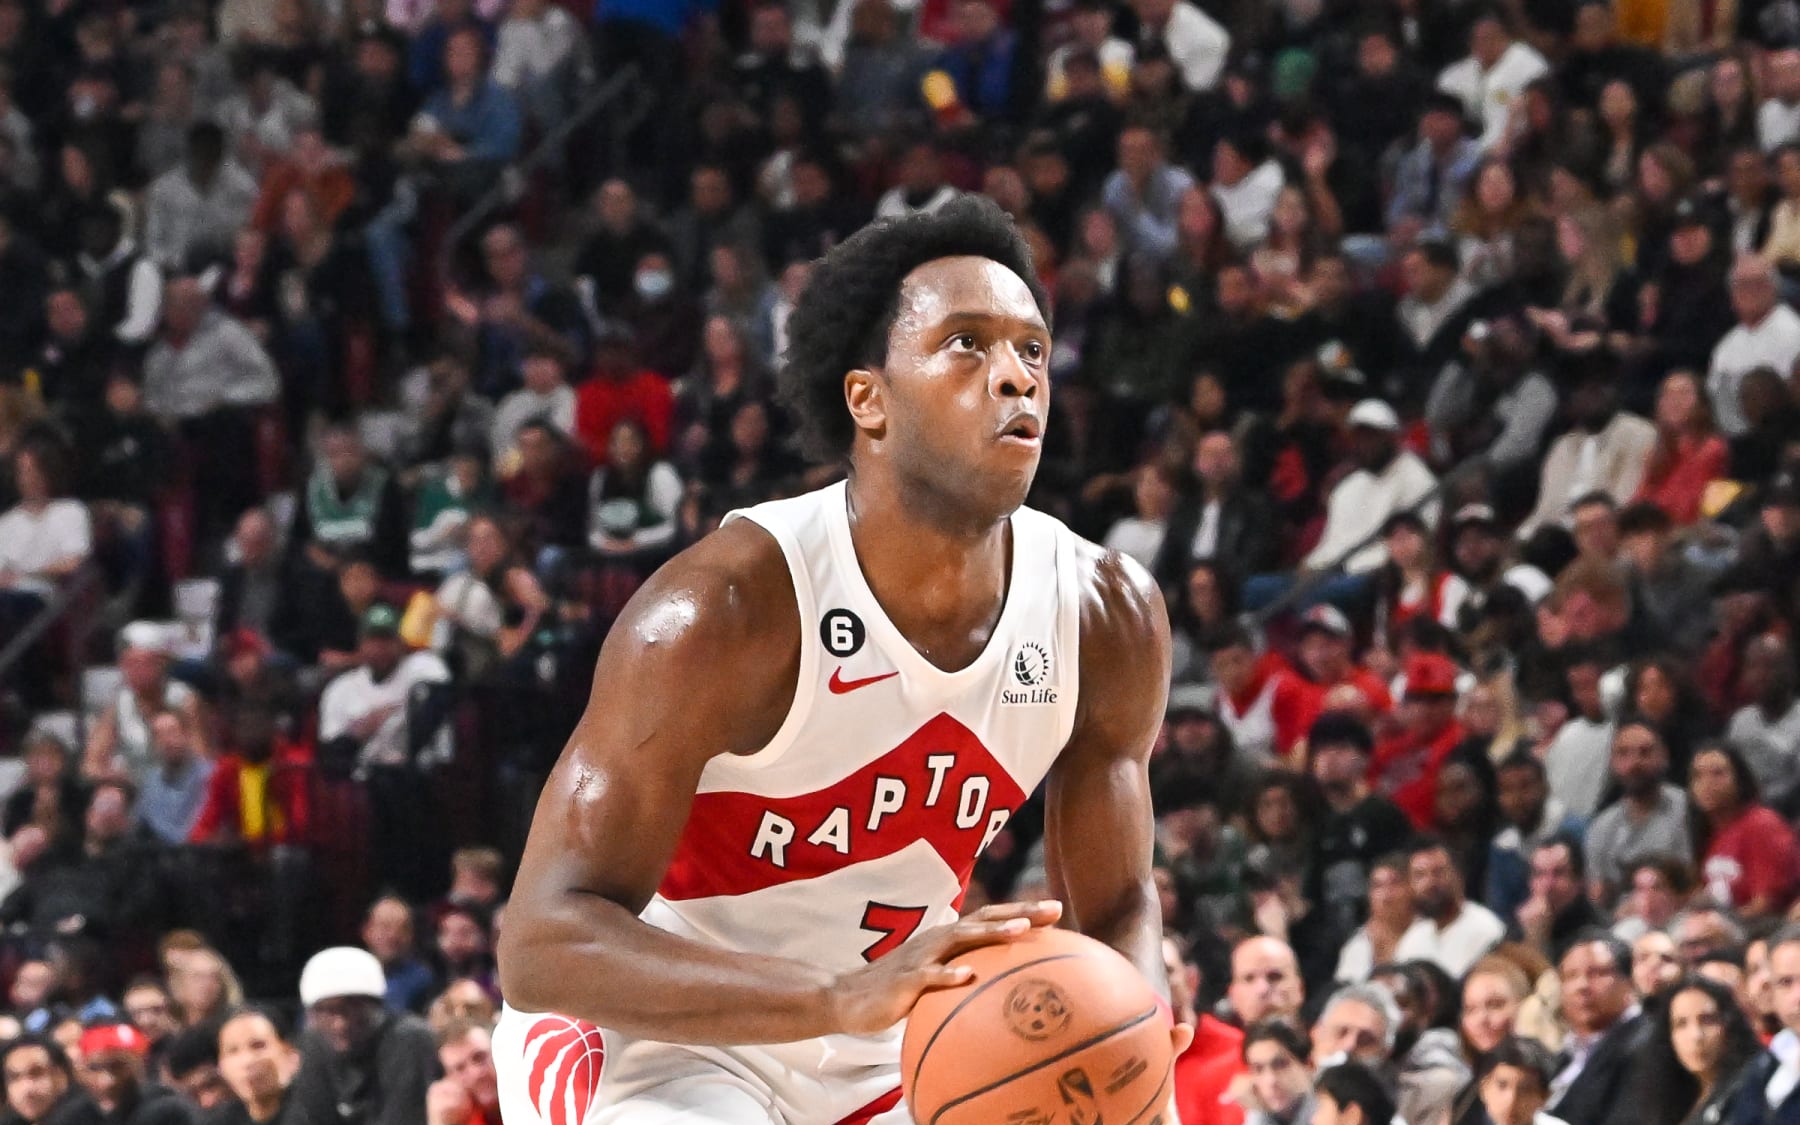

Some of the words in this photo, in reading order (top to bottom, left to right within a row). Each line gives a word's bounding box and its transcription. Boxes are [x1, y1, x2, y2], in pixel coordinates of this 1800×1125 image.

[830, 616, 854, 651] 6
[1001, 689, 1028, 704] Sun
[1031, 688, 1058, 704] Life
[860, 900, 929, 964] 7
